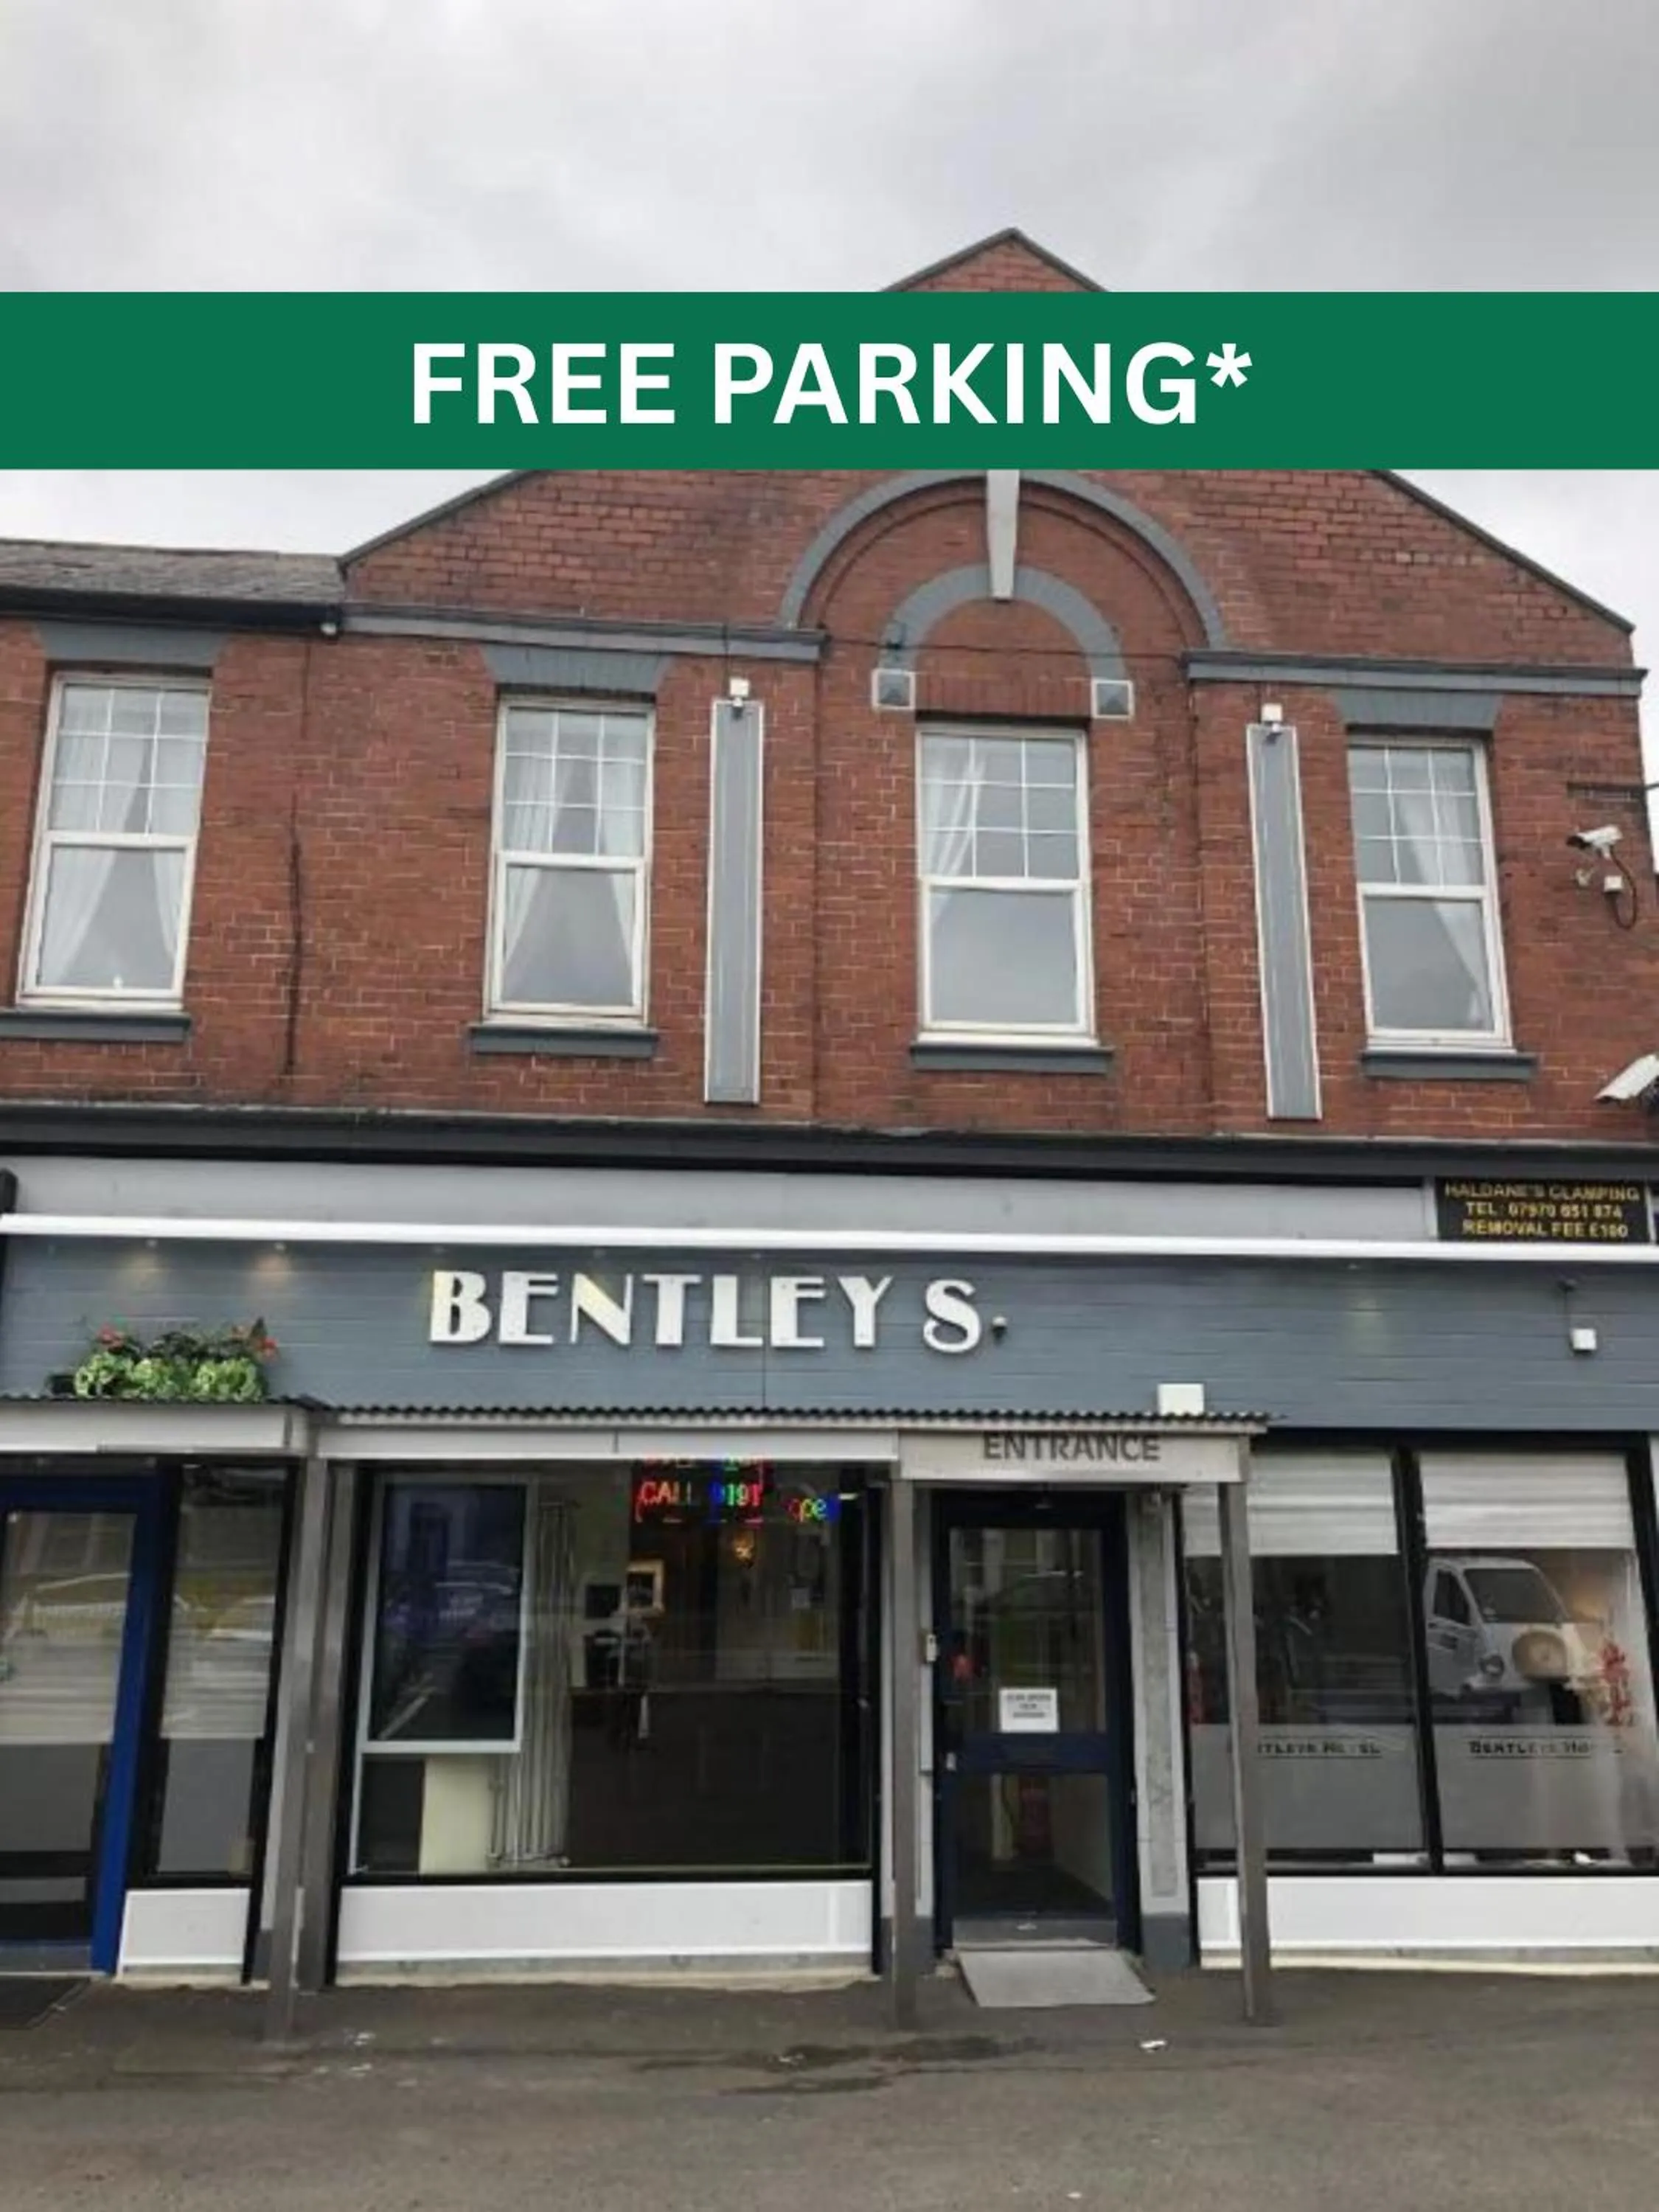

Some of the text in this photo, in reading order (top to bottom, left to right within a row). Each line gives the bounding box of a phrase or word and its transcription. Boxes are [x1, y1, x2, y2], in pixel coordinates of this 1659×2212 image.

[1462, 1218, 1548, 1237] REMOVAL
[1551, 1221, 1585, 1238] FEE
[983, 1431, 1162, 1461] ENTRANCE
